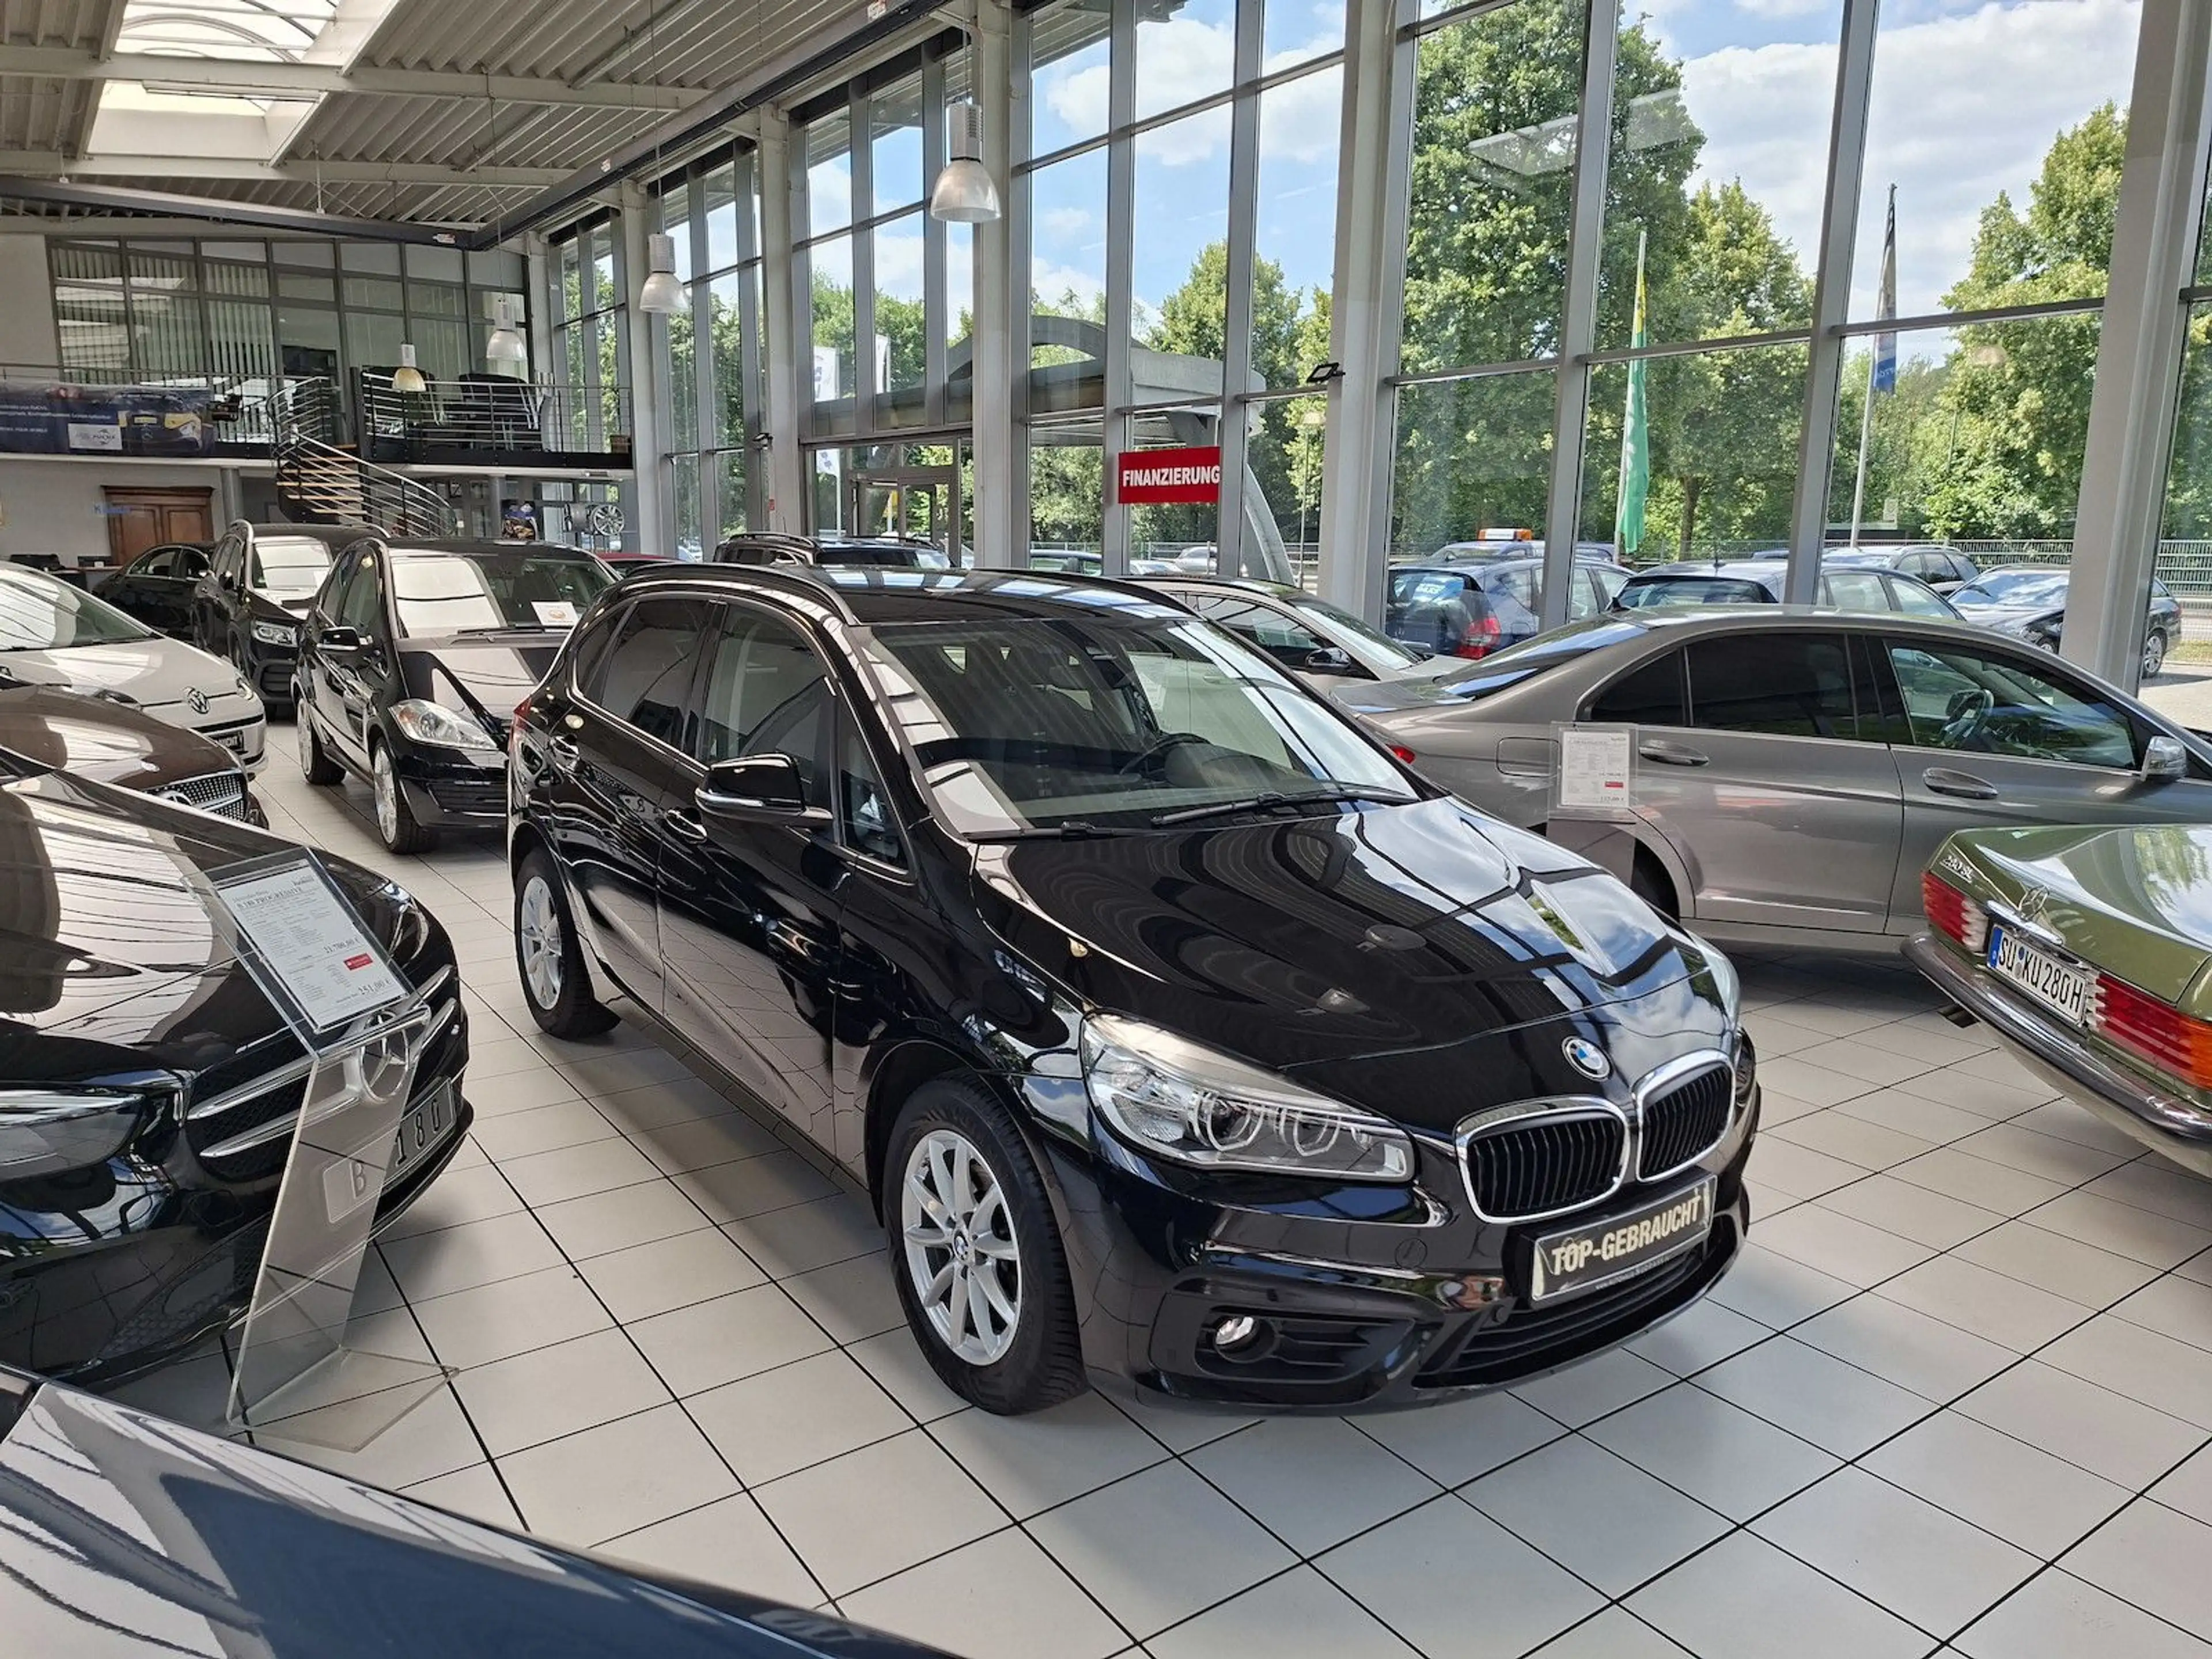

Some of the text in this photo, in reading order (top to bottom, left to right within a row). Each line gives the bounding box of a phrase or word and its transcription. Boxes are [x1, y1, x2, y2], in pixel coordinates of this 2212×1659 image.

[1123, 465, 1221, 487] FINANZIERUNG
[1999, 937, 2017, 972] SU
[2022, 951, 2043, 988] KU
[395, 1098, 441, 1168] 180
[1551, 1195, 1702, 1276] TOP-GEBRAUCHT
